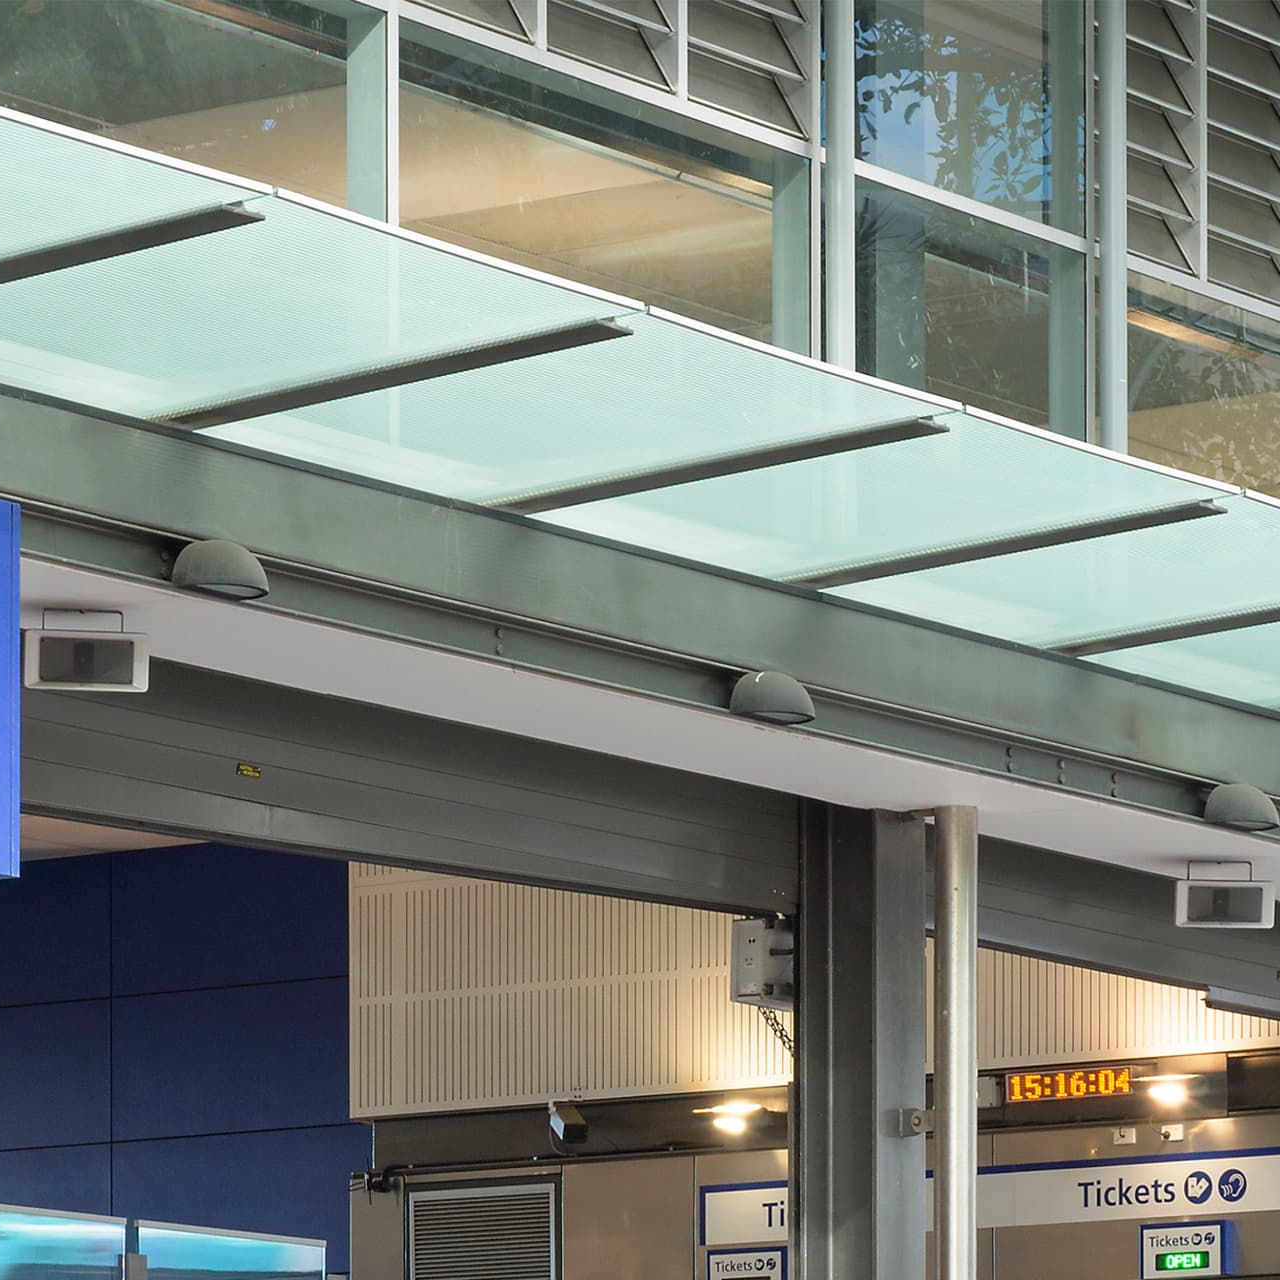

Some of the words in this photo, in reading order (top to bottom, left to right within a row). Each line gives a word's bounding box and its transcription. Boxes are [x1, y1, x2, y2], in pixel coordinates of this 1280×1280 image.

[1010, 1068, 1131, 1101] 15:16:04
[1077, 1178, 1176, 1208] Tickets
[1148, 1234, 1190, 1248] Tickets
[714, 1260, 753, 1273] Tickets
[1165, 1253, 1201, 1269] OPEN
